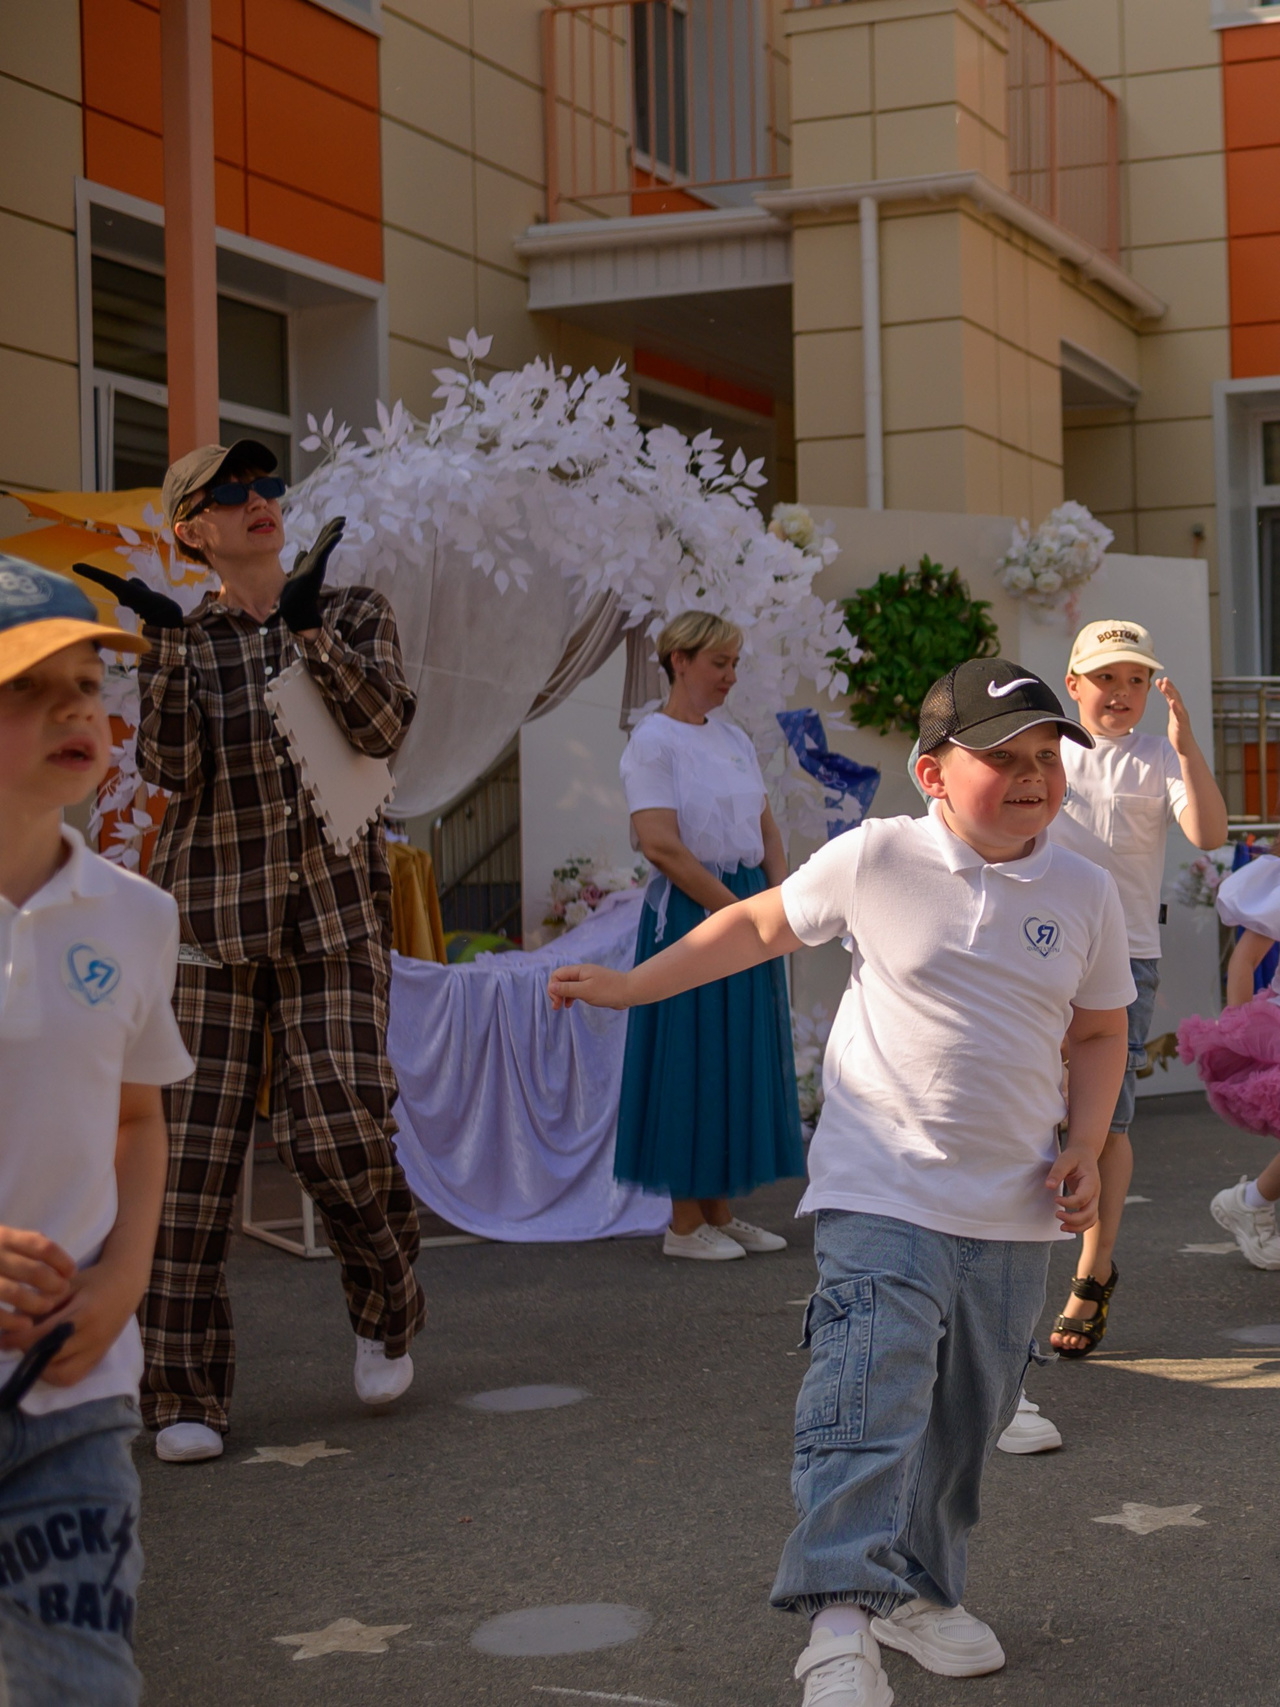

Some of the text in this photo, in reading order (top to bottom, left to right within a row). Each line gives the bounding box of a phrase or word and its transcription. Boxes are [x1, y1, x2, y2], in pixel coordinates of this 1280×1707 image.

[1097, 629, 1139, 643] BOSTON
[1036, 924, 1055, 945] Я
[84, 959, 115, 989] Я
